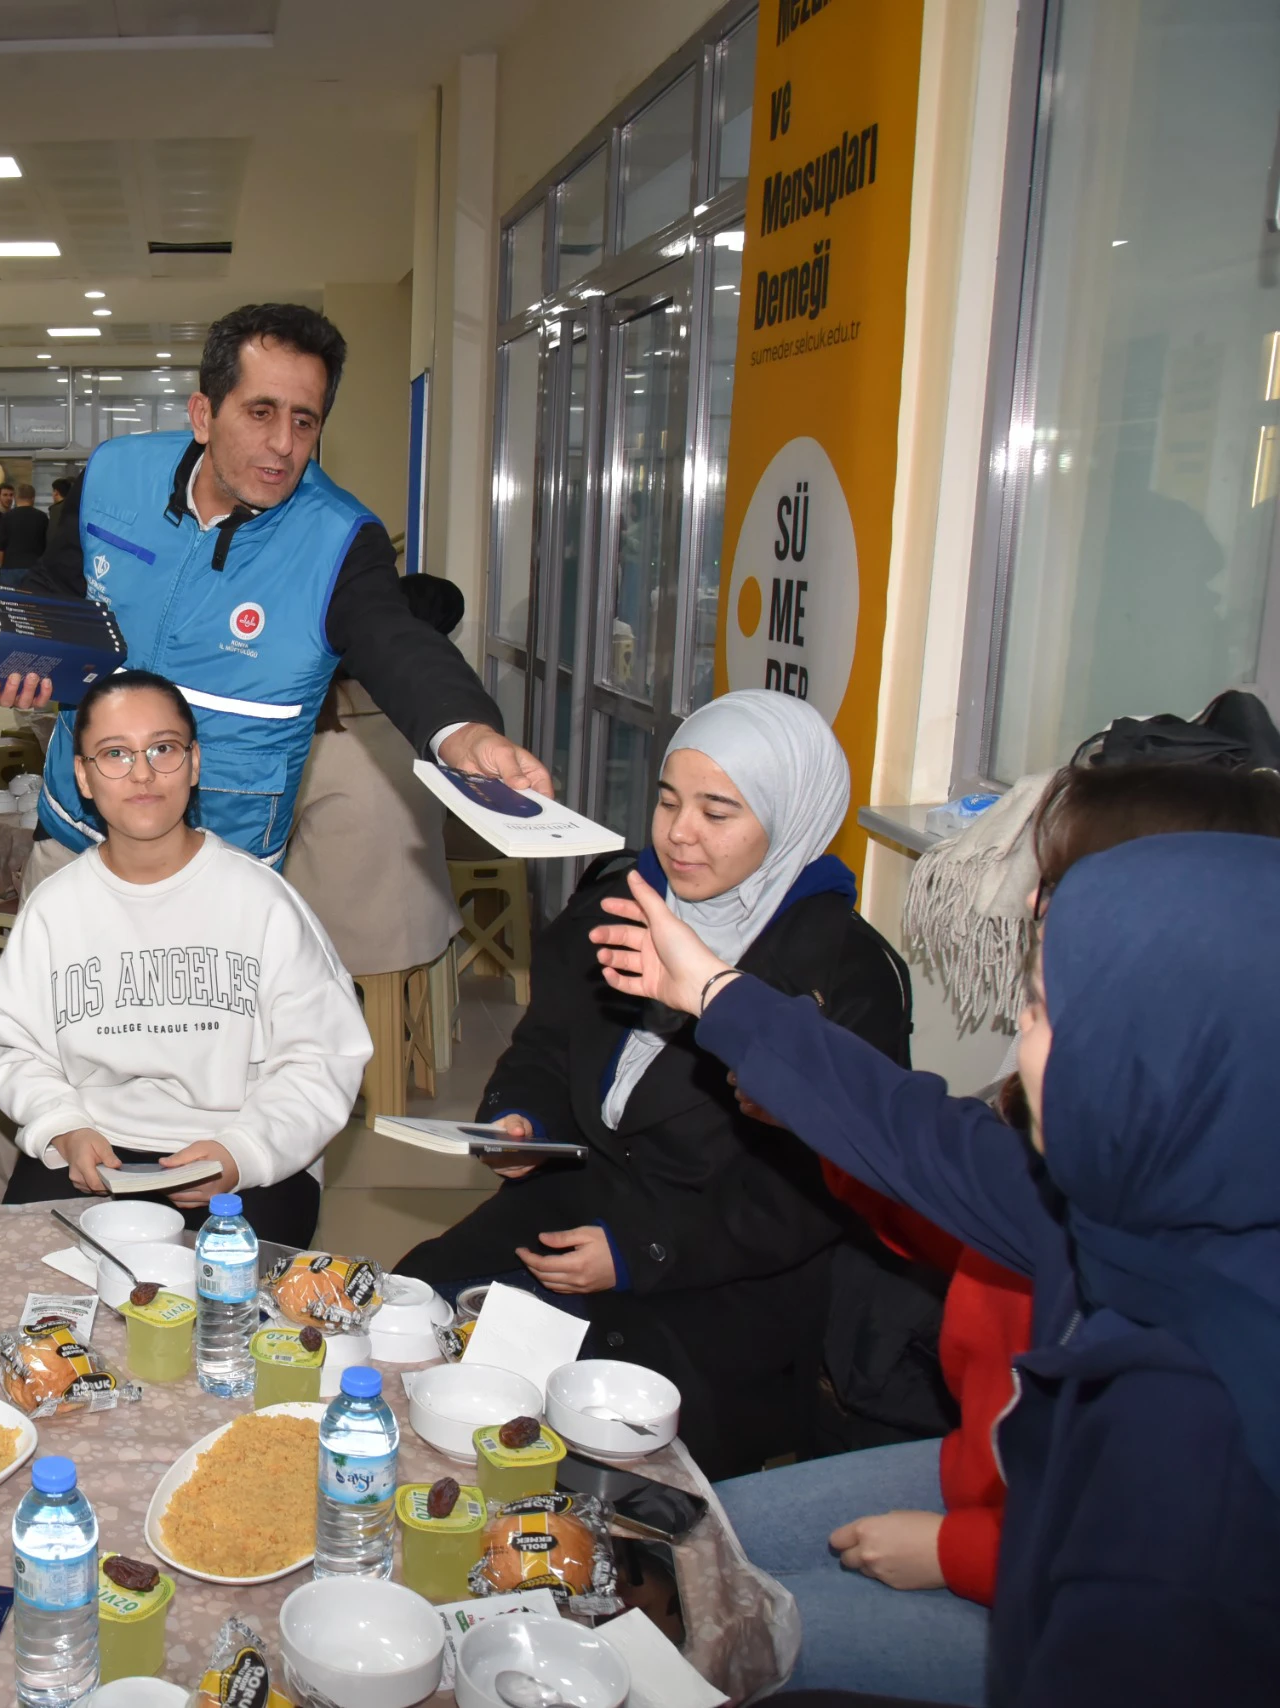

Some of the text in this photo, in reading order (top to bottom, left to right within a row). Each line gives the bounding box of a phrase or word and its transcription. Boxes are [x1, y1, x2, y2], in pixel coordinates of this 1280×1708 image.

[770, 80, 792, 141] ve
[761, 122, 879, 238] Mensupları
[754, 238, 831, 331] Derneği
[750, 320, 861, 367] sumeder.selcuk.edu.tr
[774, 481, 809, 562] SÜ
[768, 578, 809, 647] ME
[51, 946, 260, 1034] LOS ANGELES
[97, 1021, 220, 1035] COLLEGE LEAGUE 1980
[516, 1535, 553, 1544] EKMEK
